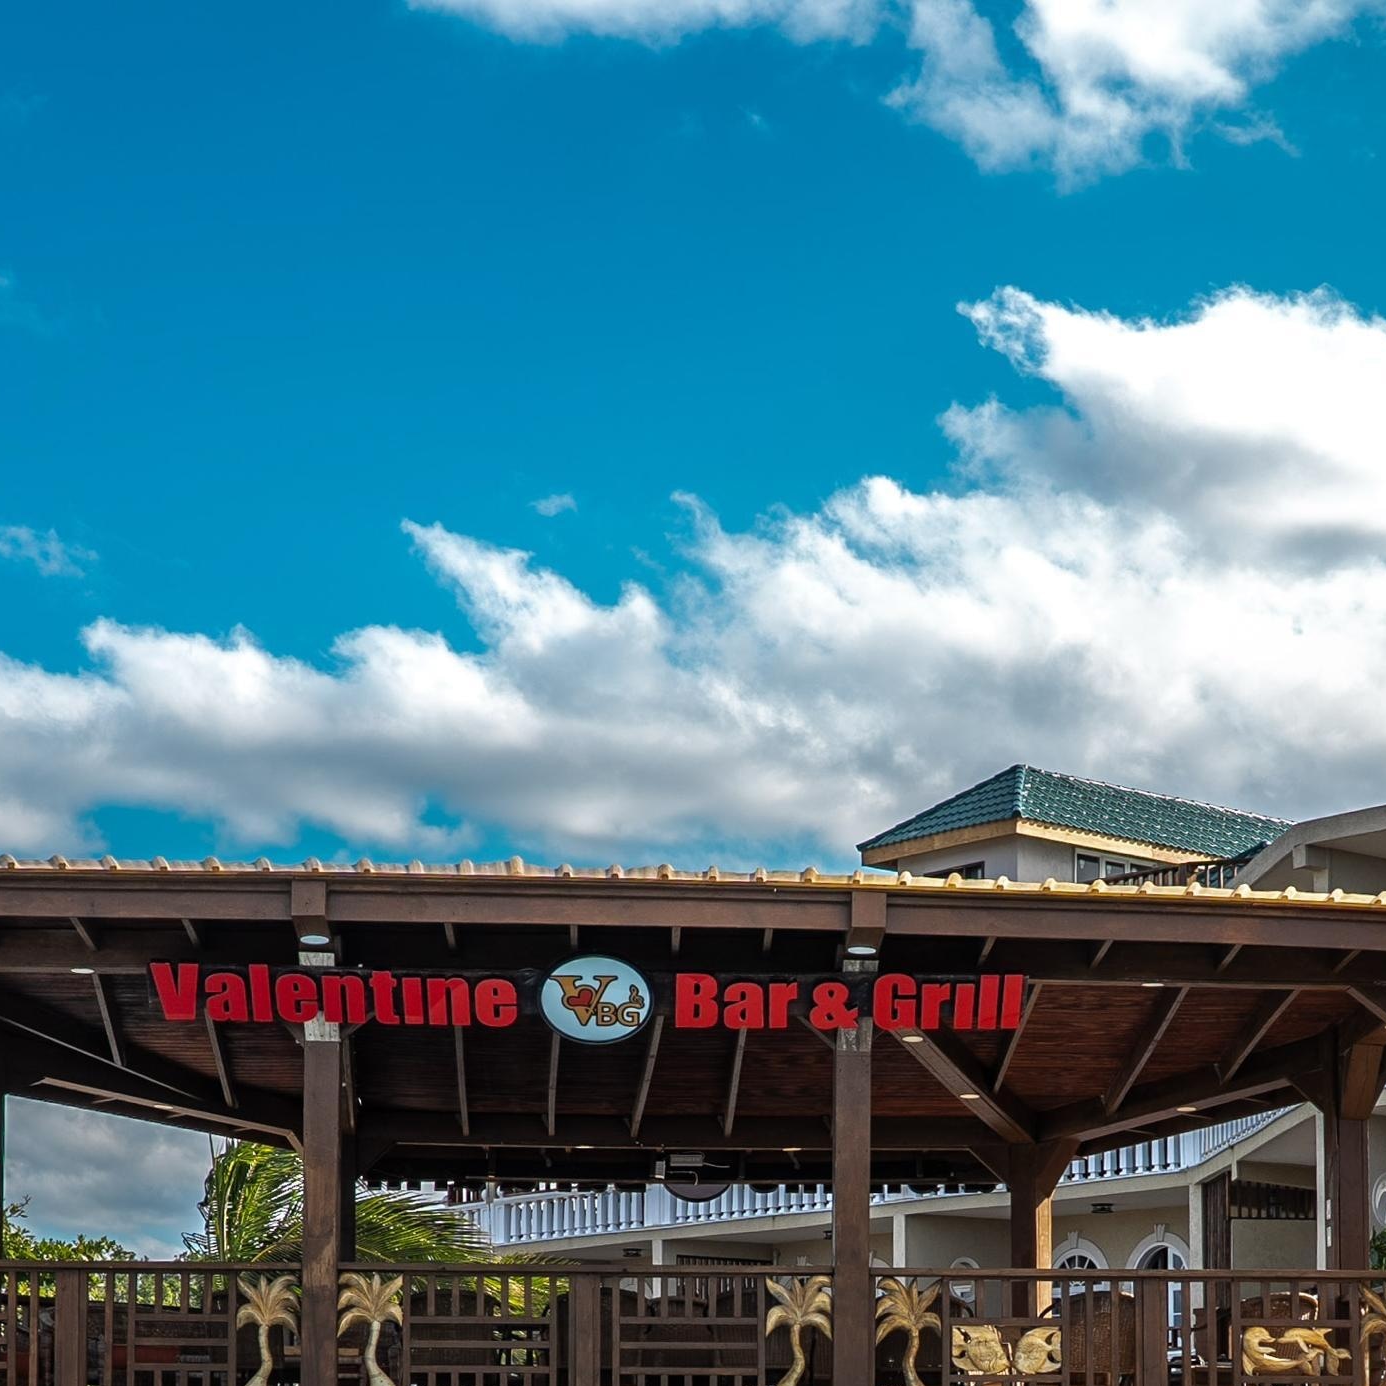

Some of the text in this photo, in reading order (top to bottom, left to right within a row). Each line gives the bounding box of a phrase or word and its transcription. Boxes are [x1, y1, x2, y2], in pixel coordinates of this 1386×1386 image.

[149, 962, 1025, 1033] Valentine Bar & Grill
